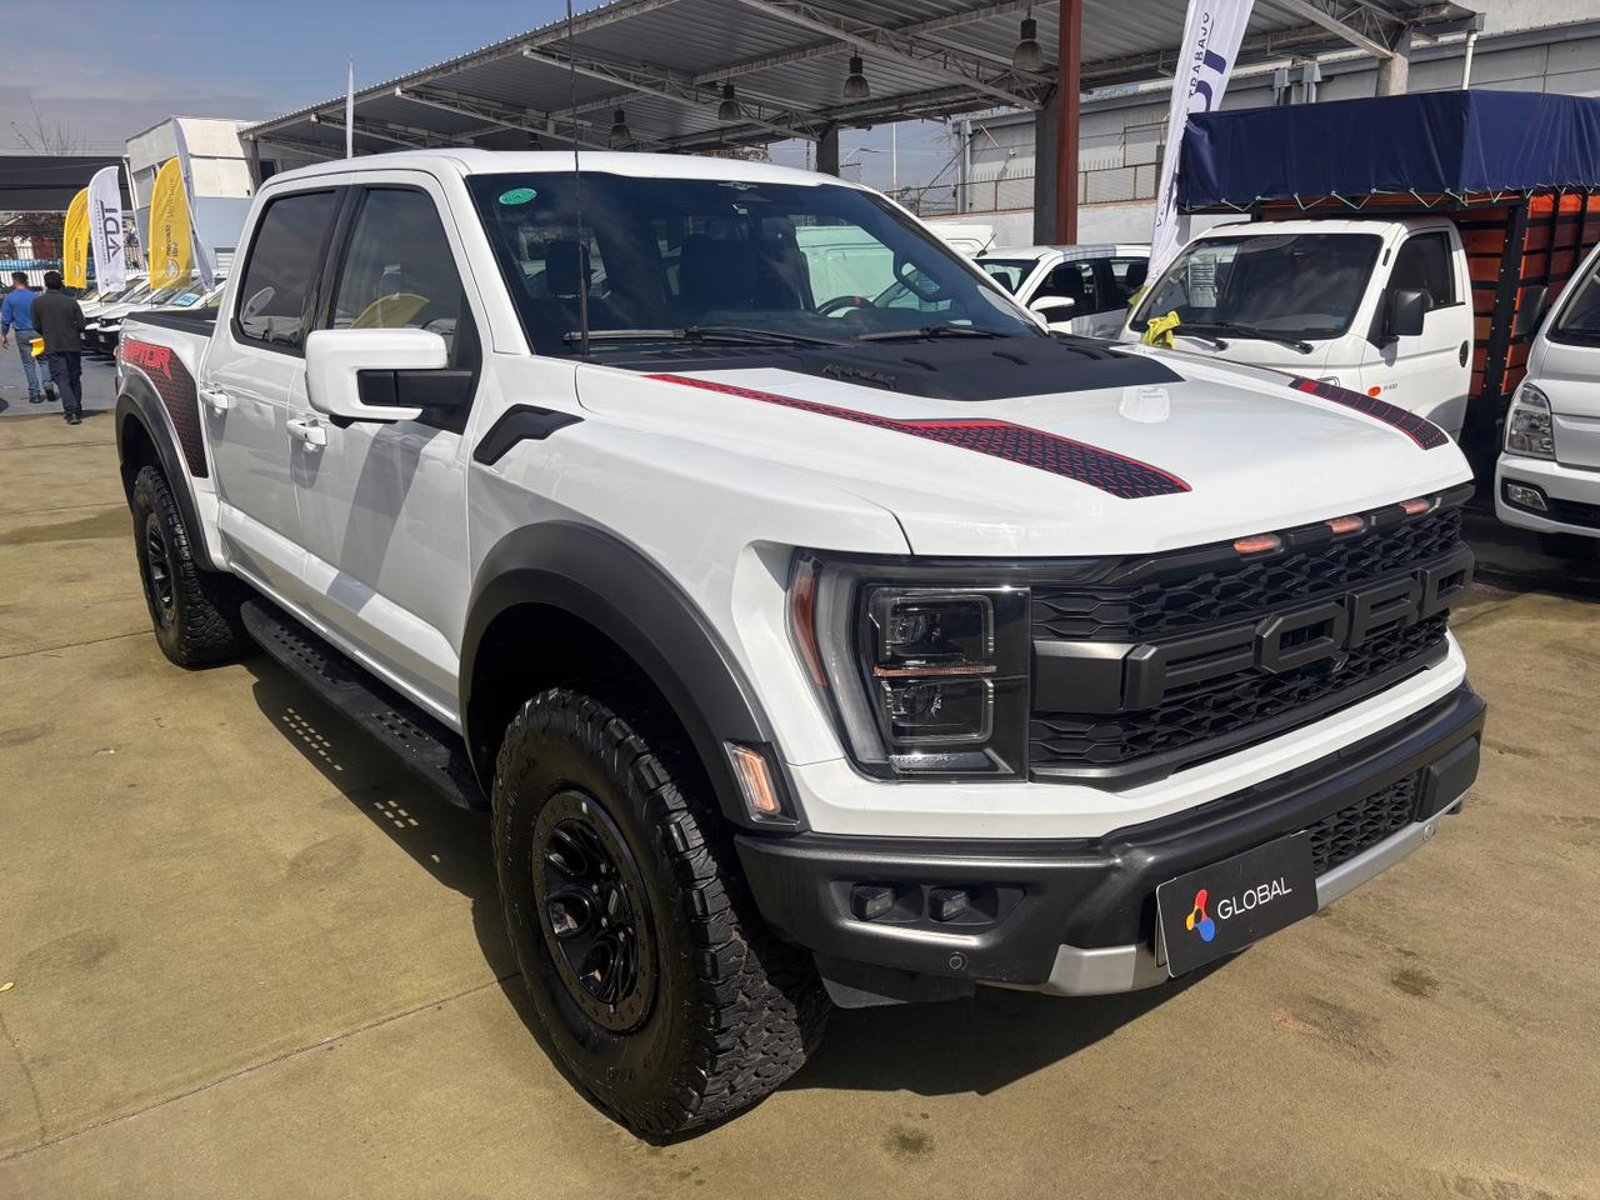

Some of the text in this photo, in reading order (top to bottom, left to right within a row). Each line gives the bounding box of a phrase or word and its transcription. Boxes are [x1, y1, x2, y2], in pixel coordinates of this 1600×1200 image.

[1189, 12, 1210, 99] TRABAJO
[1124, 549, 1474, 711] FORD
[1217, 877, 1292, 920] GLOBAL
